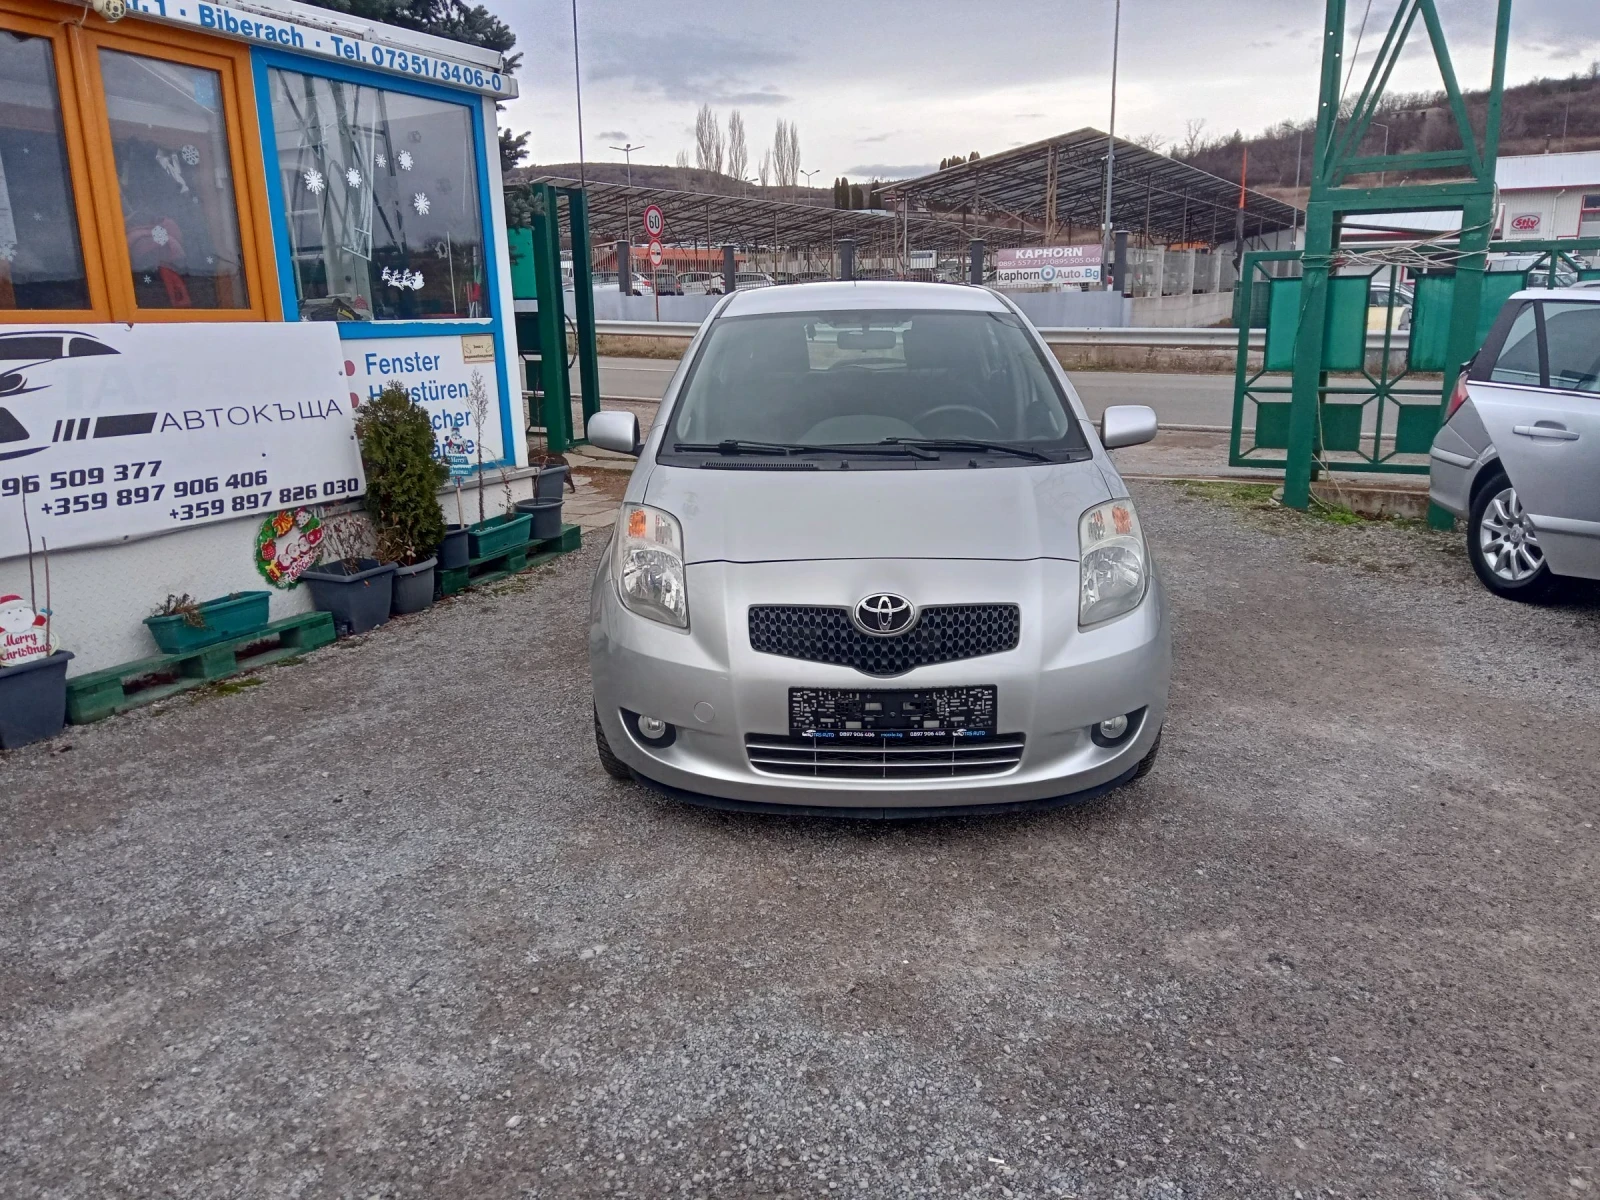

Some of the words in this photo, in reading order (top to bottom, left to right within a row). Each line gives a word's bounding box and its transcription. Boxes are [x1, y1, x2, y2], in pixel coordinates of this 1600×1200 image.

[199, 4, 304, 48] Biberach
[330, 36, 367, 63] Tel.
[372, 46, 502, 91] 07351/3406-0
[649, 215, 660, 229] 60
[1516, 218, 1536, 226] Stiv
[1016, 247, 1083, 258] KAPHORN
[365, 352, 440, 375] Fenster
[369, 380, 469, 402] Hstüren
[160, 399, 343, 432] АВТОКЪЩА
[50, 467, 104, 490] 509
[114, 460, 162, 482] 377
[41, 492, 107, 516] +359
[117, 484, 165, 506] 897
[174, 477, 218, 498] 906
[225, 470, 267, 489] 406
[169, 499, 224, 521] +359
[231, 491, 272, 512] 897
[279, 484, 317, 504] 826
[323, 478, 359, 496] 030
[4, 632, 38, 647] Merry
